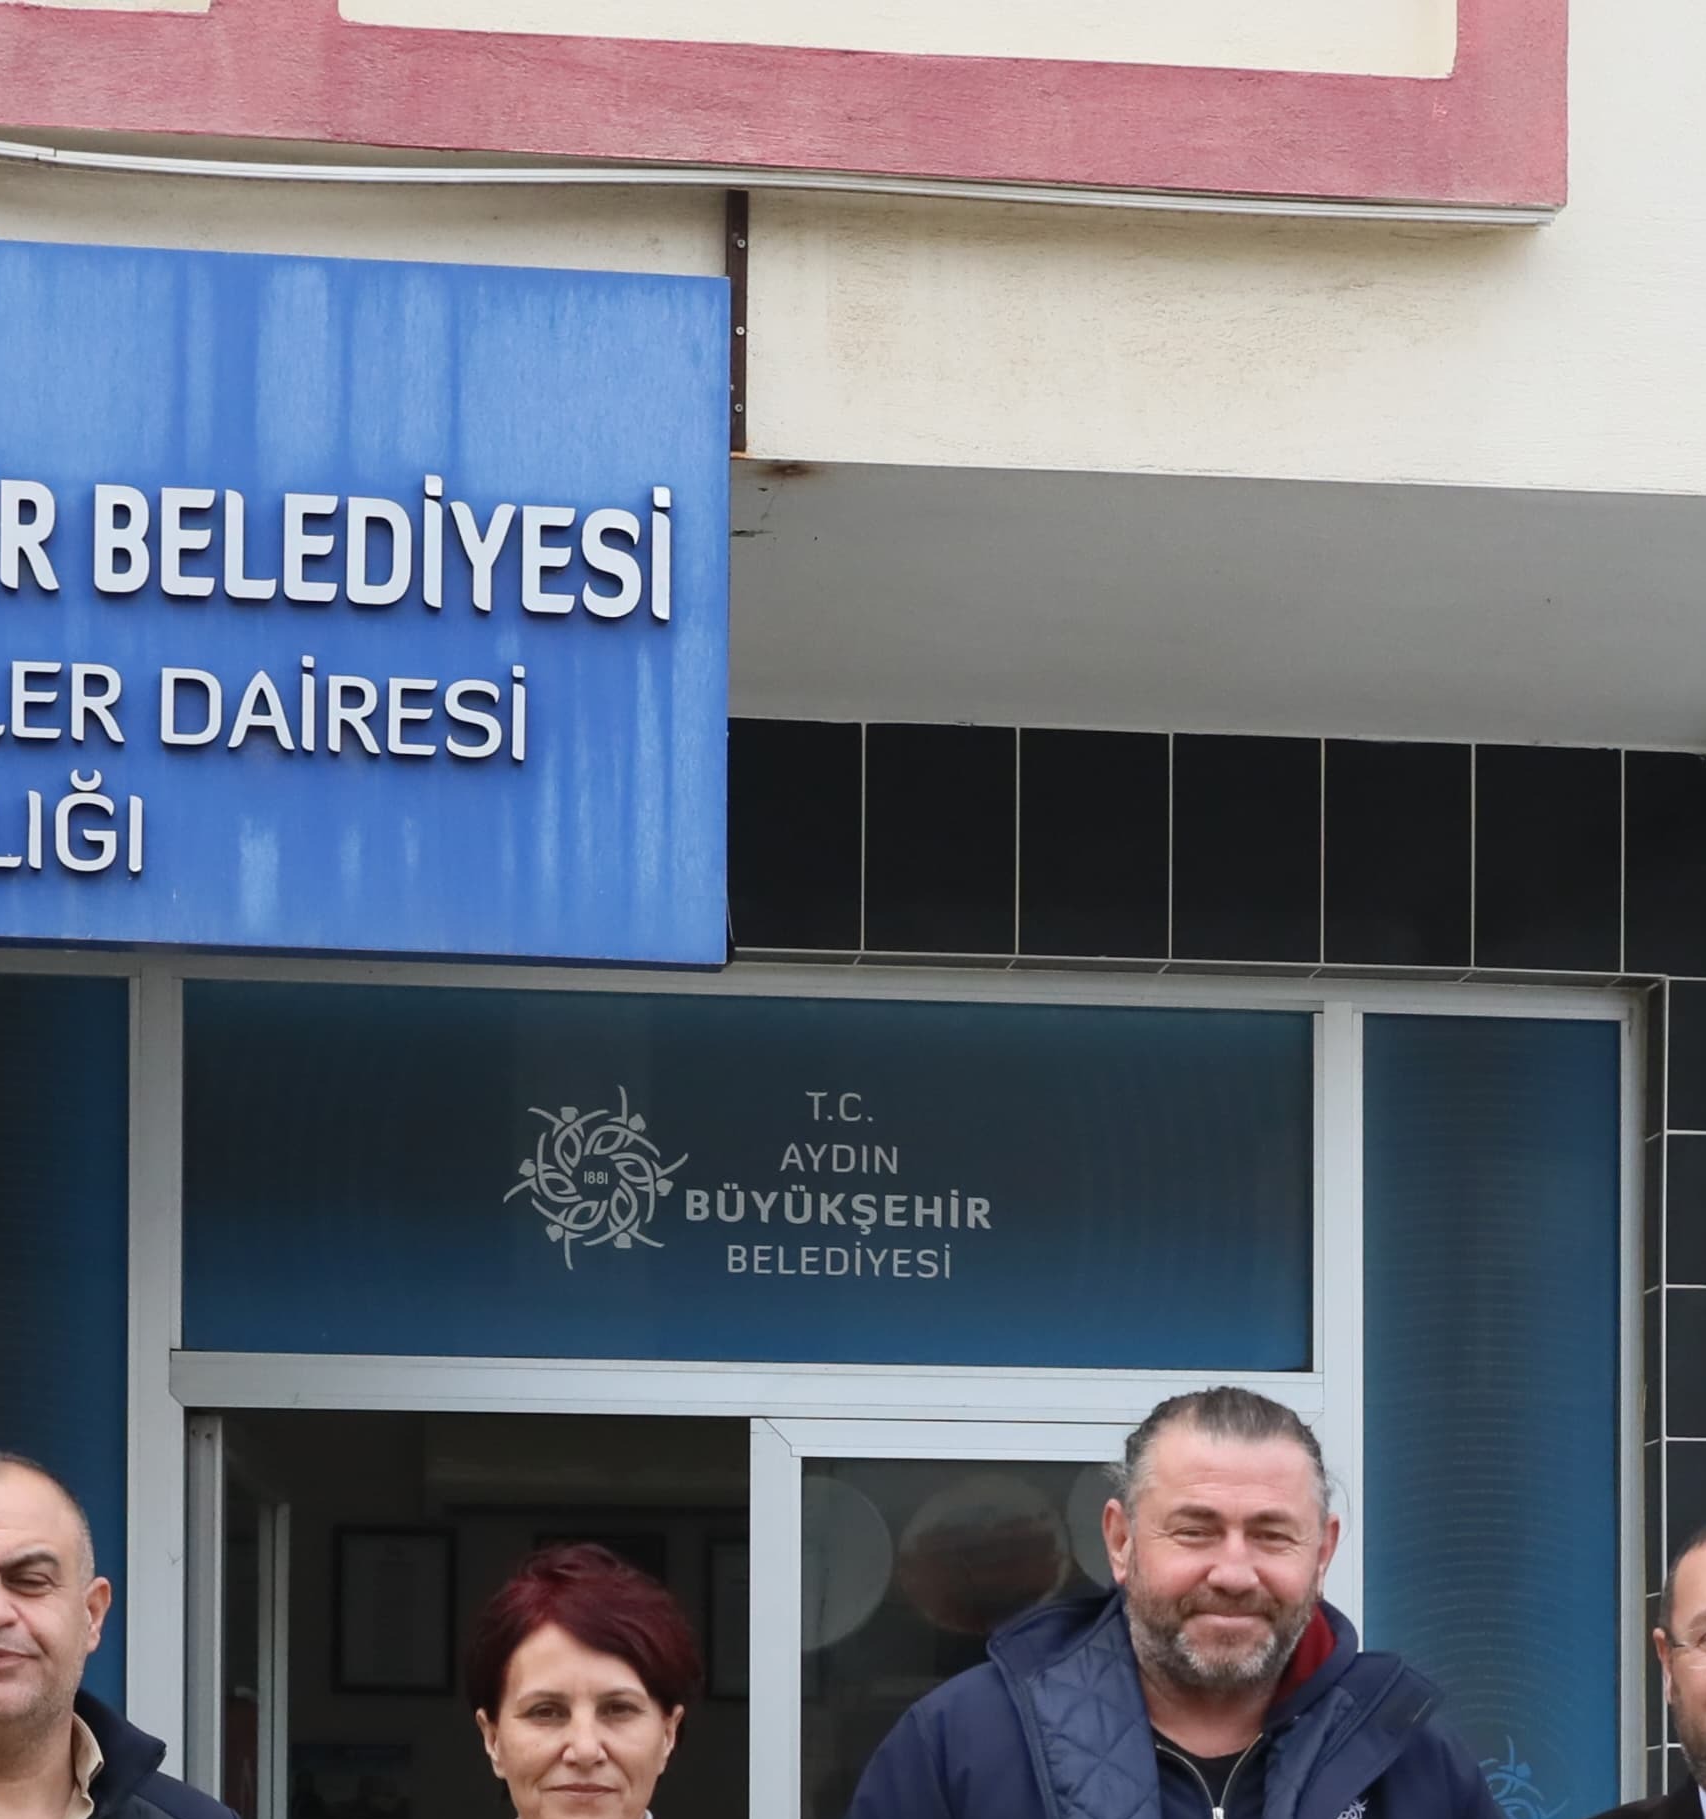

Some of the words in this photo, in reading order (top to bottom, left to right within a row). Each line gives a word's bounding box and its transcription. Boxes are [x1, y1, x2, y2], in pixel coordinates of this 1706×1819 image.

[94, 474, 672, 621] BELEDİYESİ
[160, 655, 527, 762] DAİRESİ
[805, 1091, 875, 1122] T.C.
[779, 1142, 899, 1174] AYDIN
[583, 1170, 609, 1185] 1881
[684, 1182, 992, 1236] BÜYÜKŞEHİR
[726, 1241, 952, 1279] BELEDİYESİ
